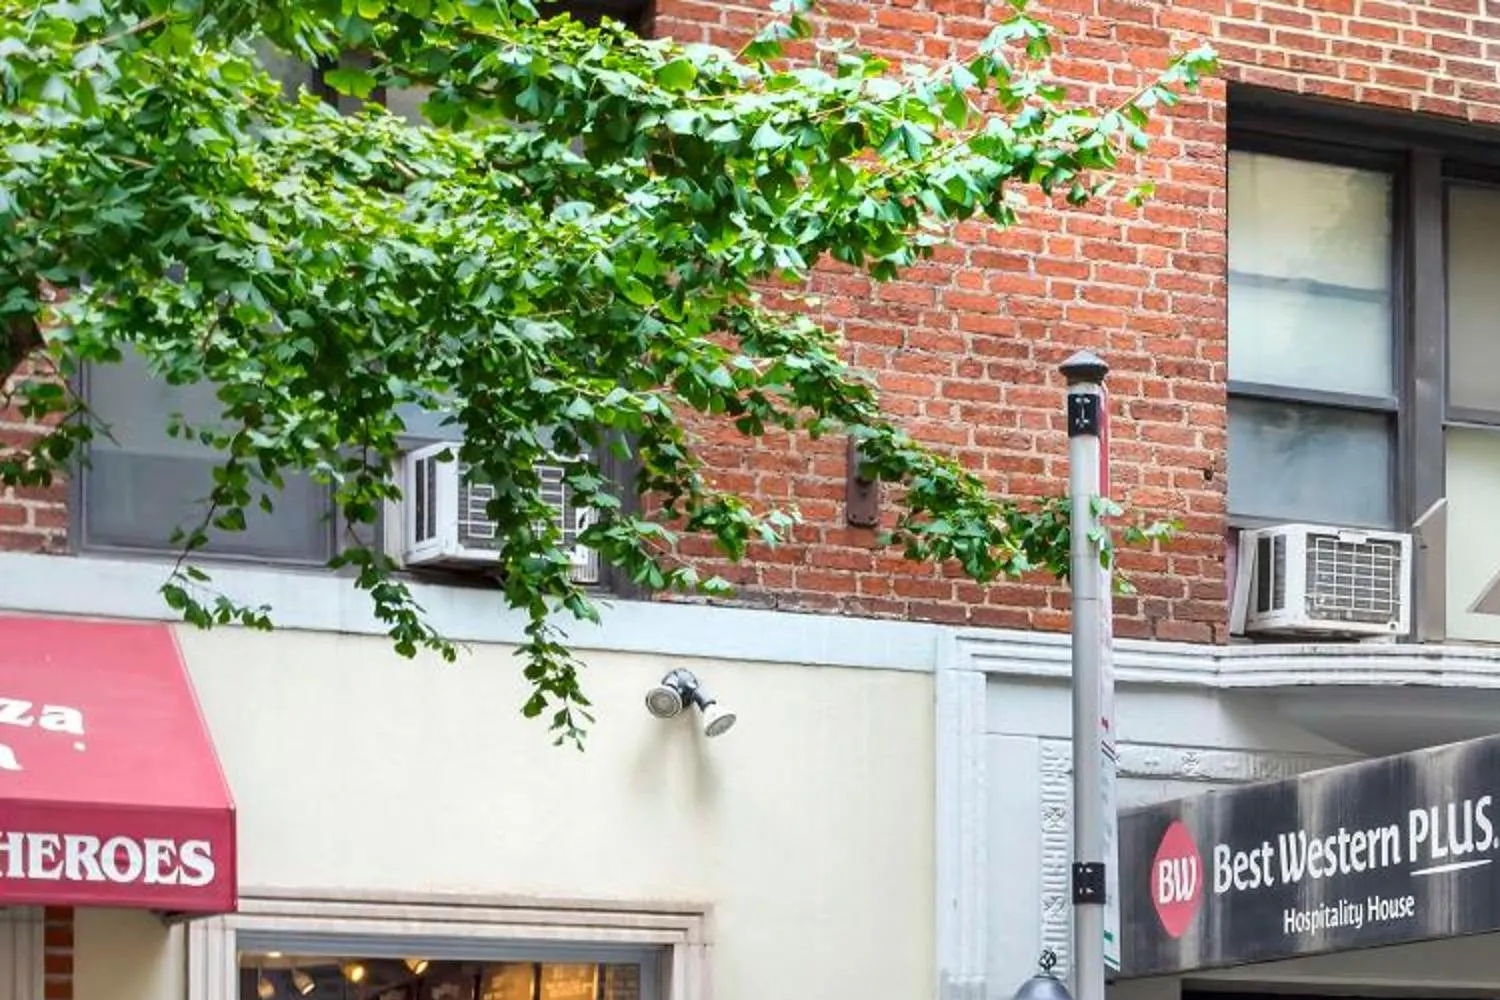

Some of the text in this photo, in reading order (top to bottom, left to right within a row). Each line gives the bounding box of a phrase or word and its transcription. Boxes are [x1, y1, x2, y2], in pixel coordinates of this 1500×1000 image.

[1158, 855, 1198, 904] BW
[1213, 841, 1275, 895] Best
[1278, 823, 1401, 884] Western
[1283, 895, 1415, 936] Hospitality House
